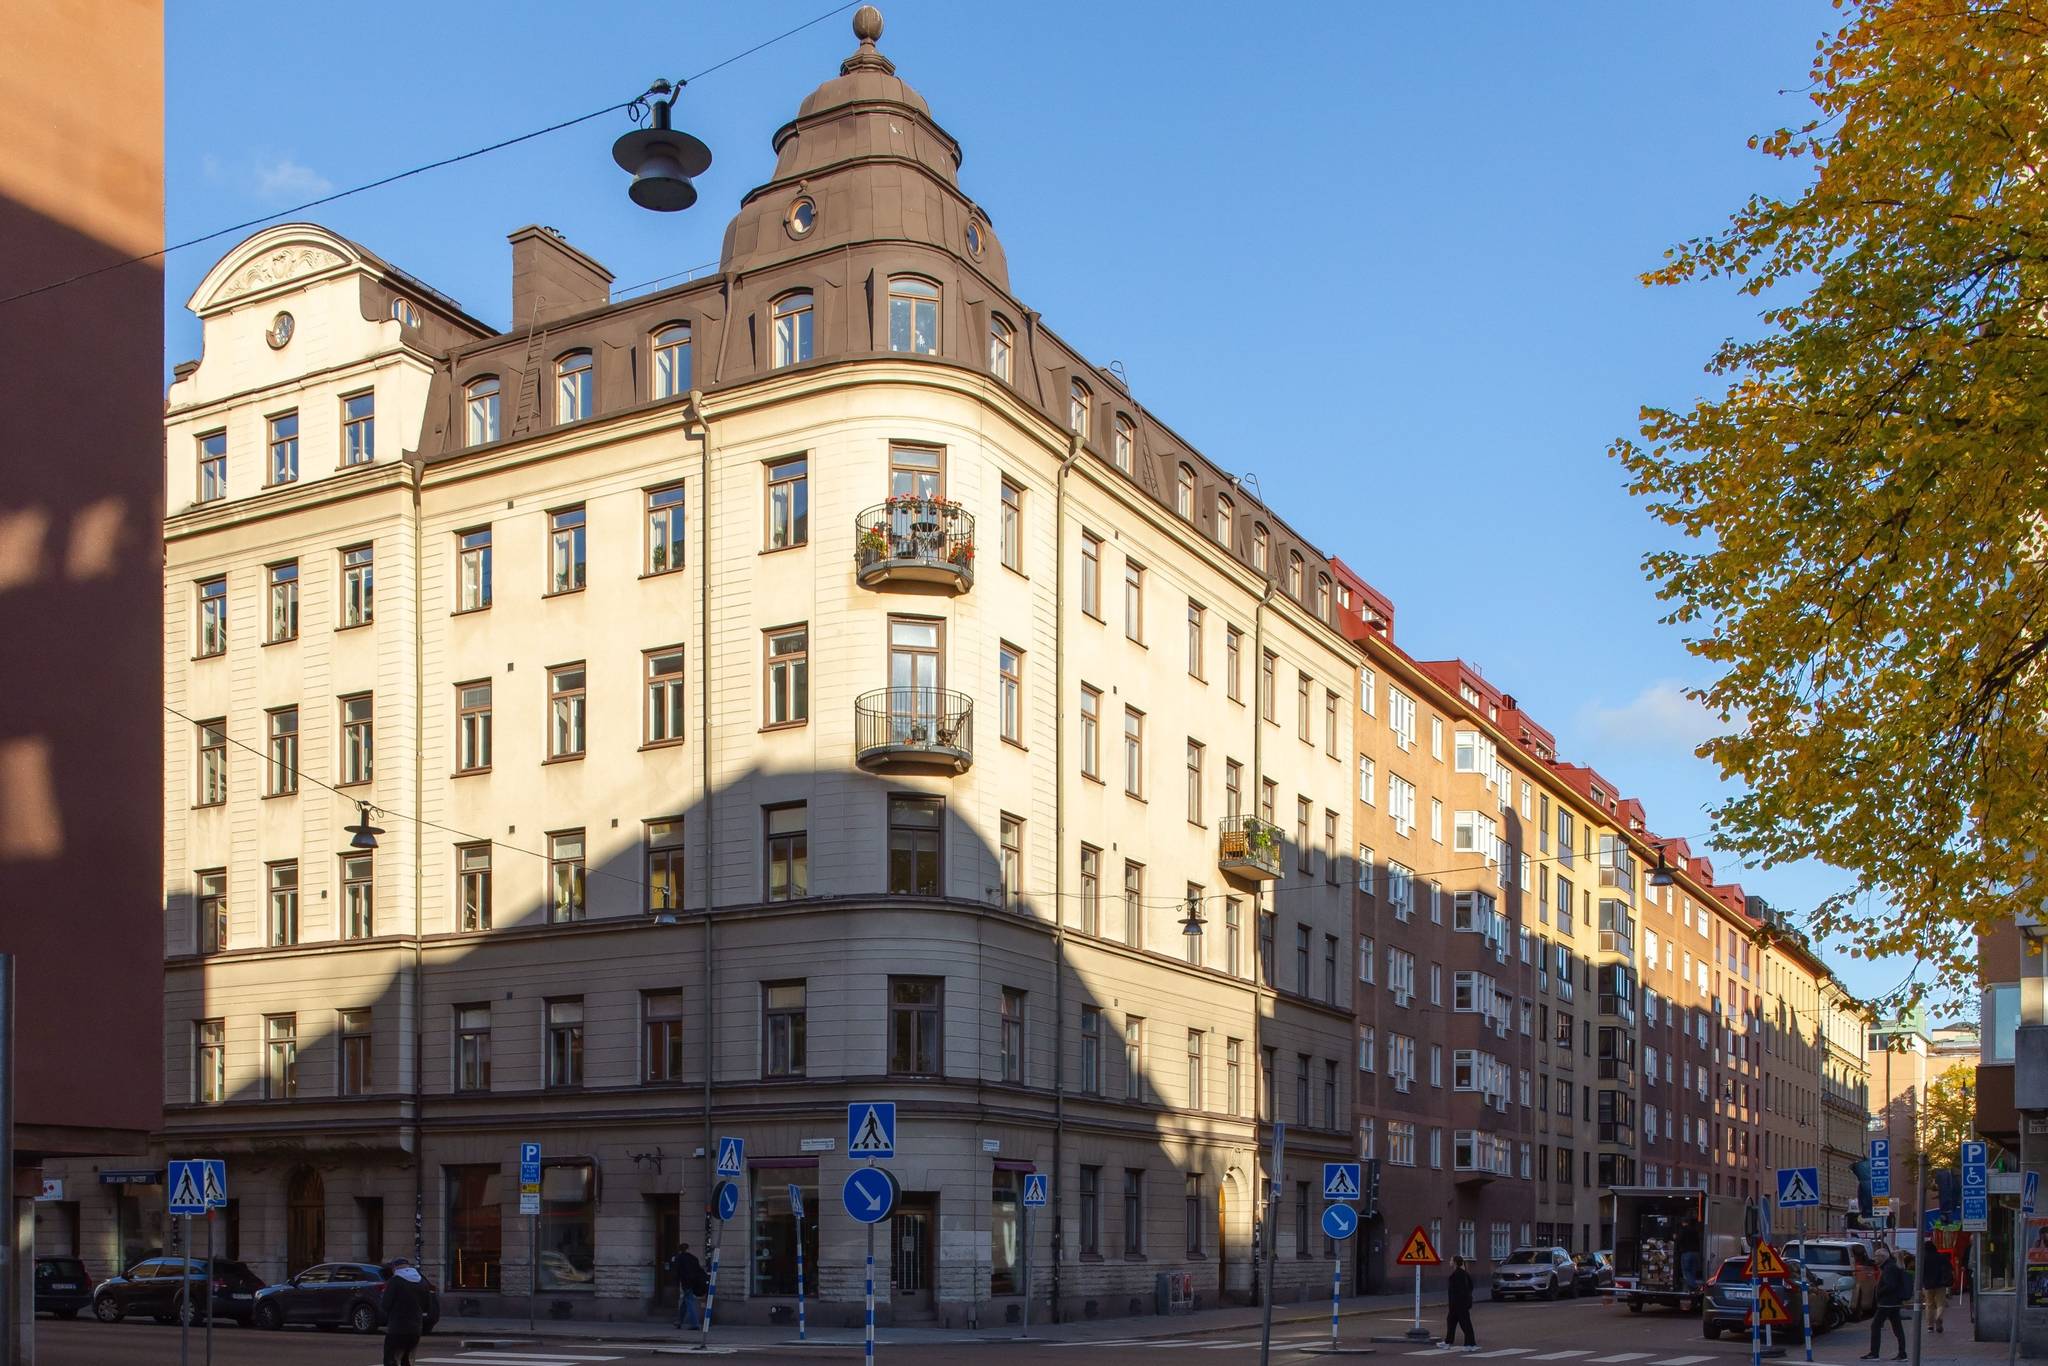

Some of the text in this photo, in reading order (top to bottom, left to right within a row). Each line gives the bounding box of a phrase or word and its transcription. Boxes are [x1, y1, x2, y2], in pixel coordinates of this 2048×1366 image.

[526, 1146, 537, 1161] P
[1875, 1141, 1886, 1157] P
[1968, 1145, 1981, 1162] P
